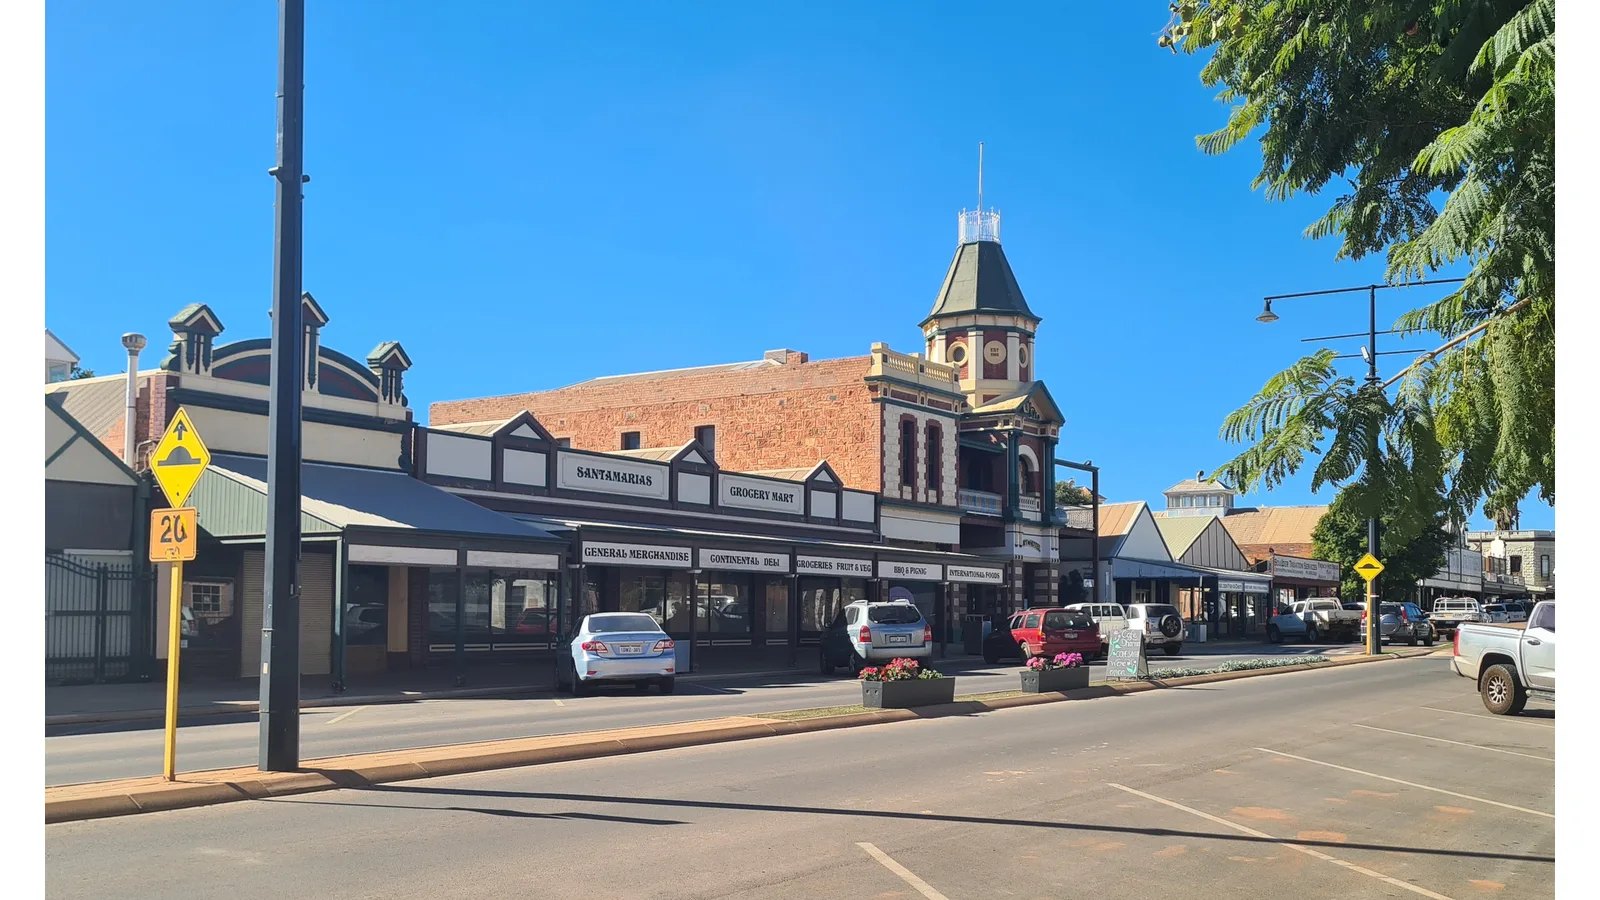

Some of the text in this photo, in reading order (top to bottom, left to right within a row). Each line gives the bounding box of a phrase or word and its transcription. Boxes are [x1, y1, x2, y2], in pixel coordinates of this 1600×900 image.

[576, 466, 653, 487] SANTAMARIAS
[730, 486, 795, 503] GROCERY MART
[584, 547, 689, 562] GENERAL MERCHANDISE
[710, 554, 780, 567] CONTINENTAL DELI
[796, 559, 872, 573] GROCERIES FRUIT & VEG
[893, 565, 927, 576] BBQ & PICNIC
[949, 568, 1000, 579] INTERNATIONAL FOODS
